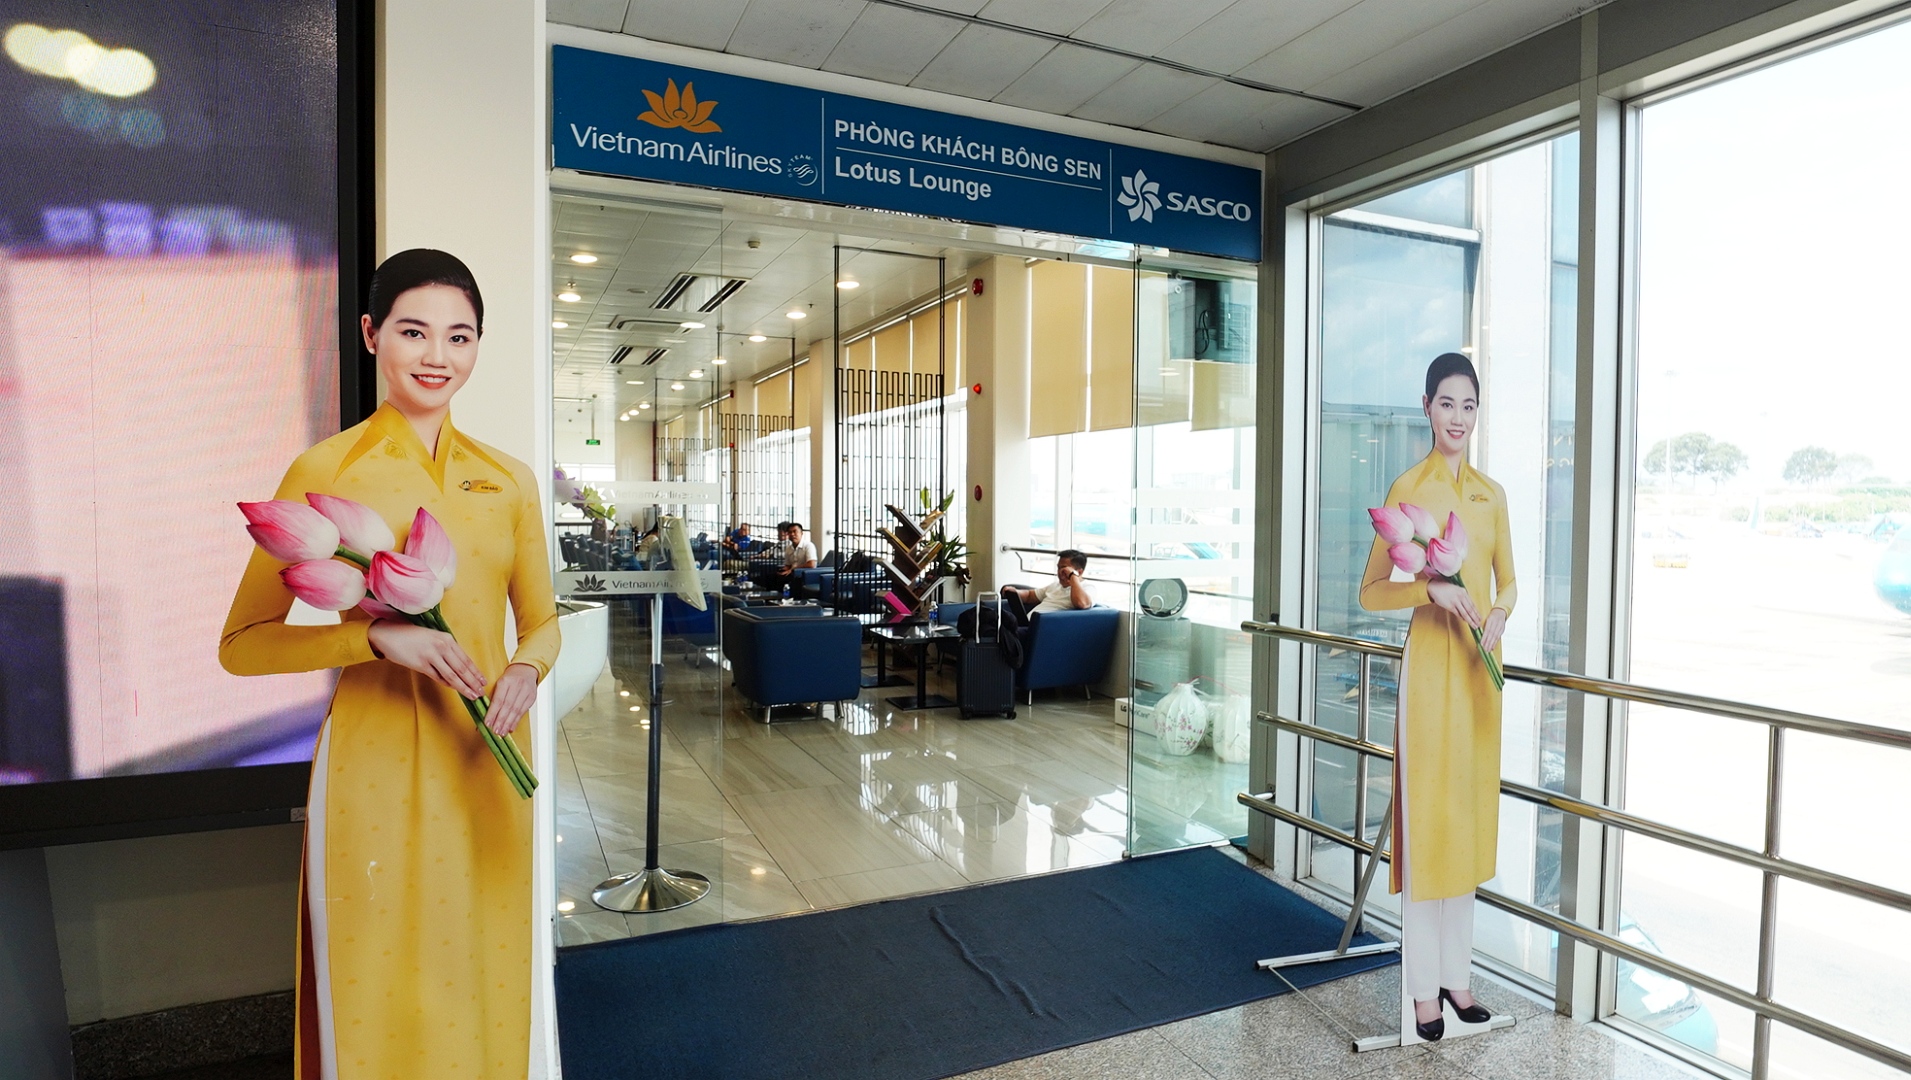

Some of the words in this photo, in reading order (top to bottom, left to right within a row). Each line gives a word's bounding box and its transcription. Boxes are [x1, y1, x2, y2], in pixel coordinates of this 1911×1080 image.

[835, 119, 915, 149] PHÒNG
[921, 136, 995, 162] KHÁCH
[1001, 147, 1058, 173] BÔNG
[1064, 158, 1101, 180] SEN
[835, 156, 901, 185] Lotus
[909, 168, 992, 201] Lounge
[1166, 191, 1252, 222] SASCO
